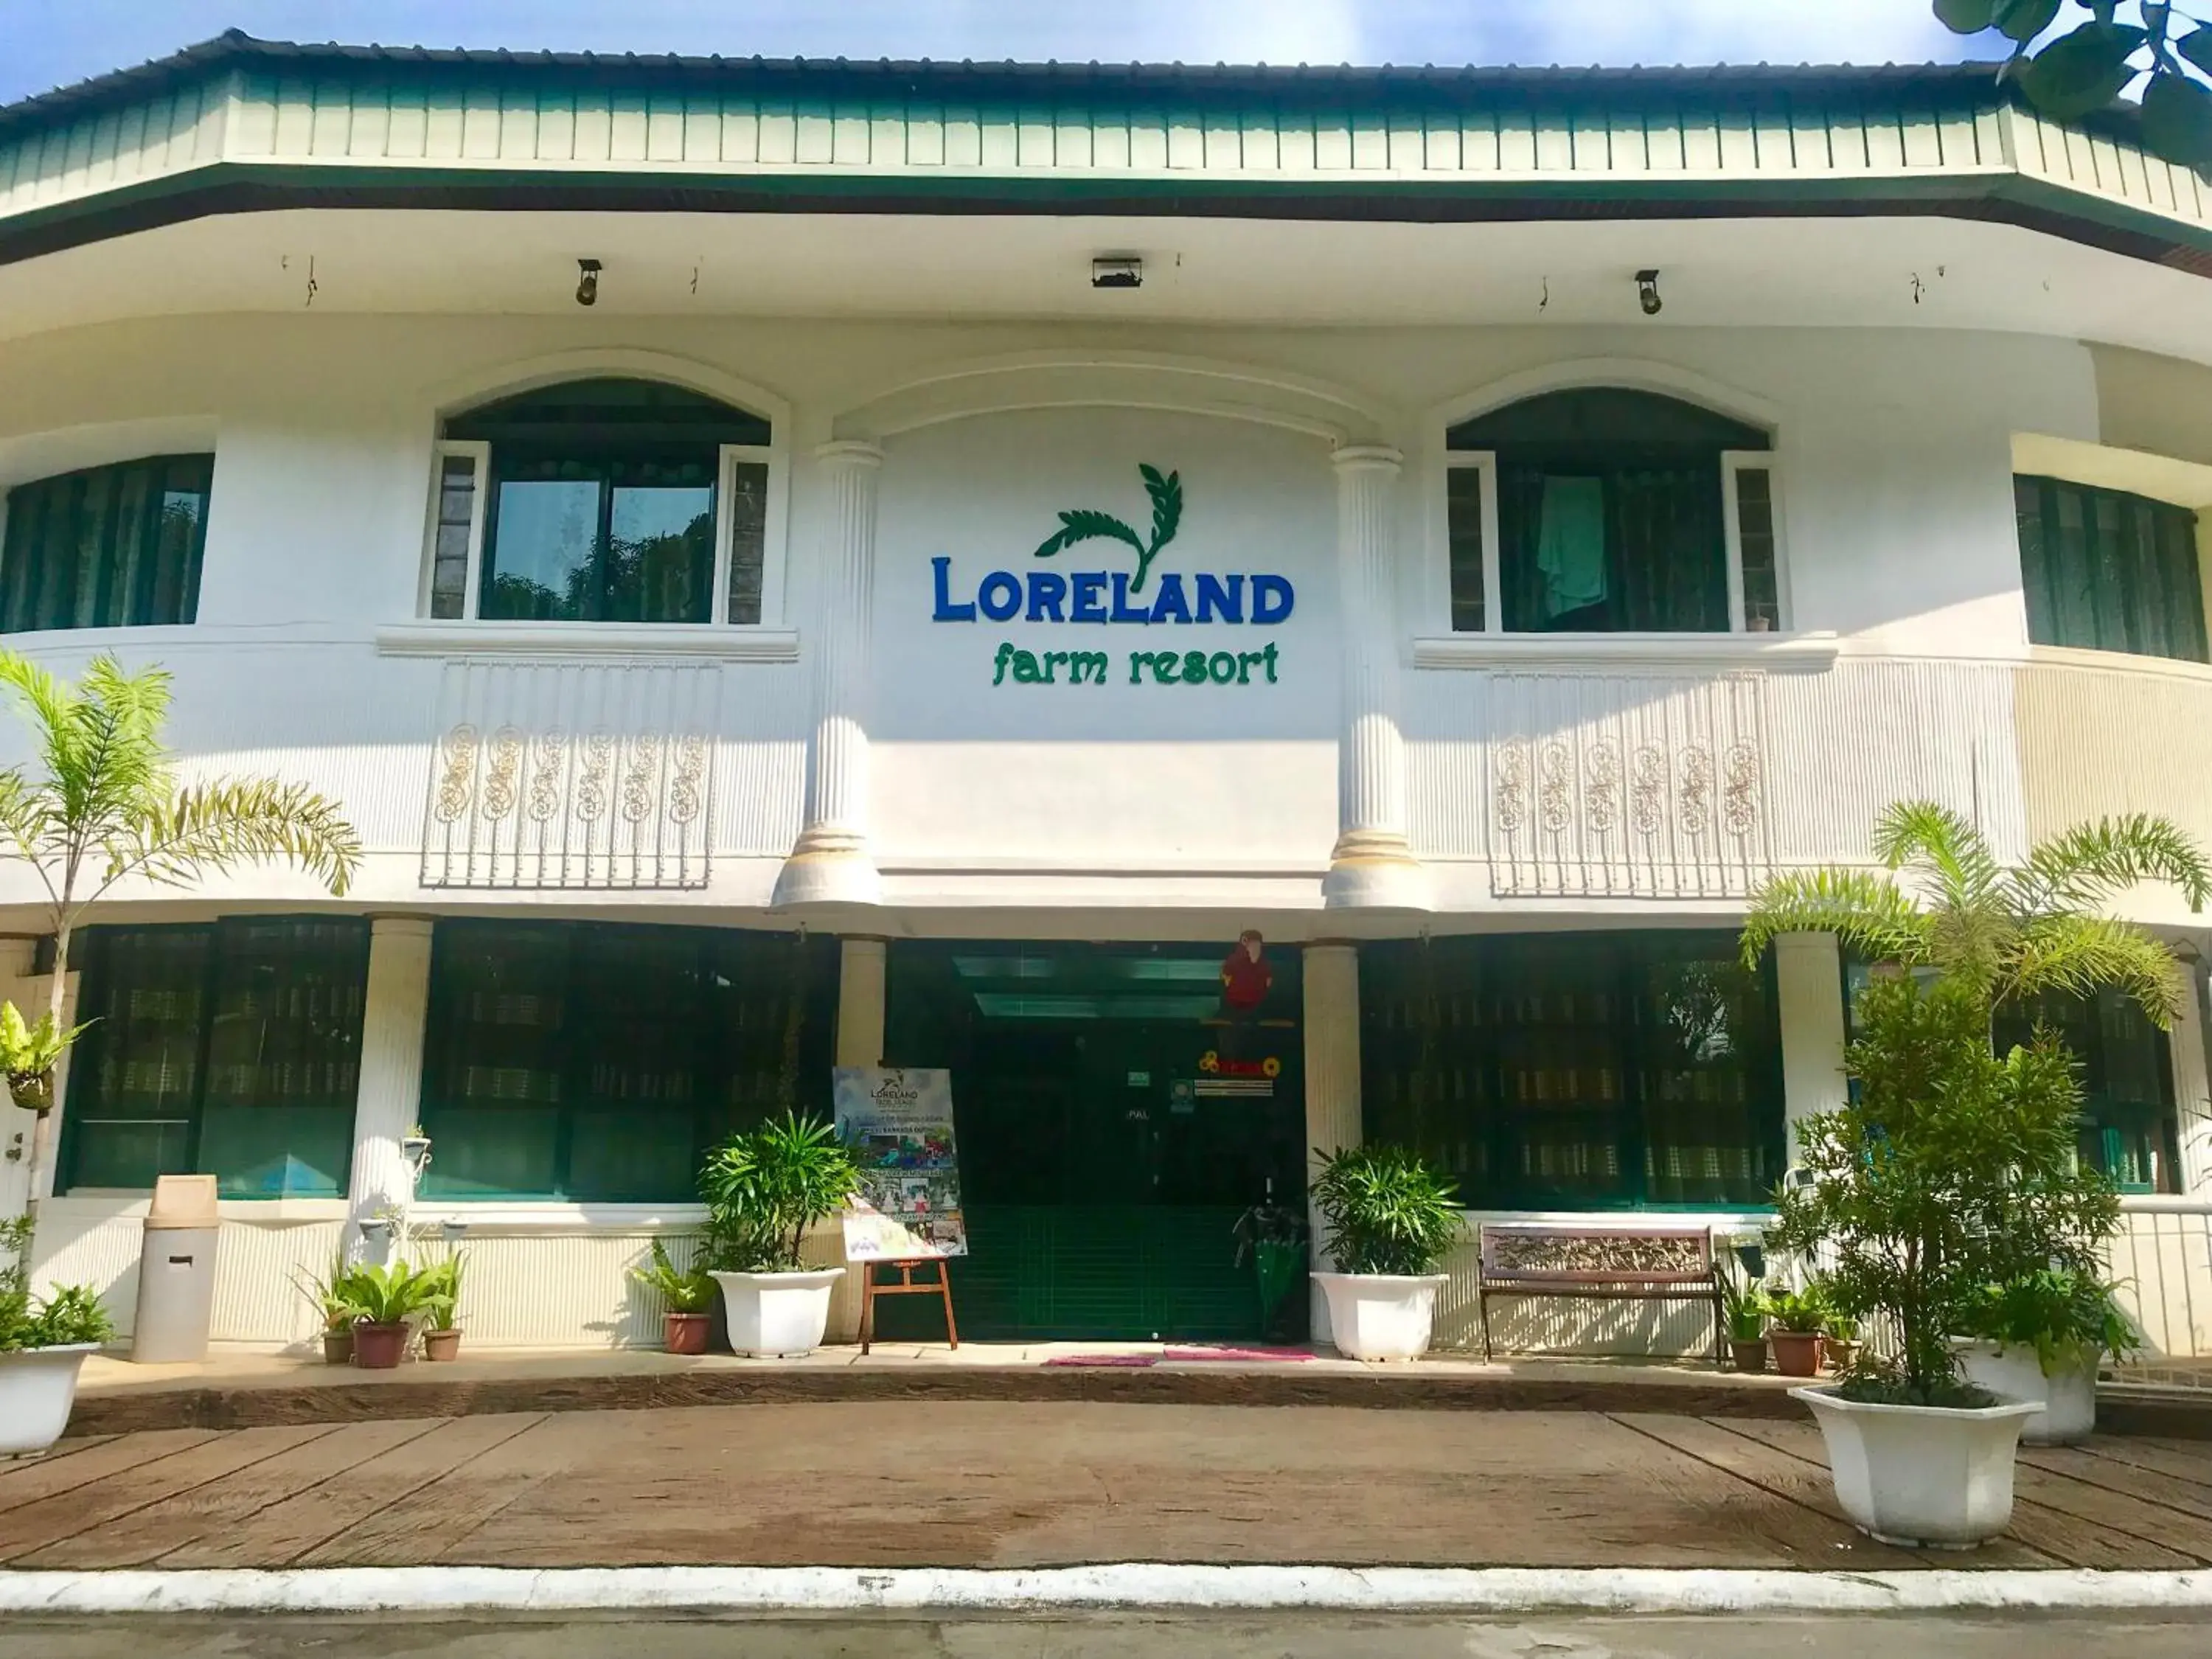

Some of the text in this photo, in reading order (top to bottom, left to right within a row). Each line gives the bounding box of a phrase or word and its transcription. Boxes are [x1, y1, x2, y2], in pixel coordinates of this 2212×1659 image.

[931, 557, 1294, 625] LORELAND
[992, 641, 1279, 686] farm resort
